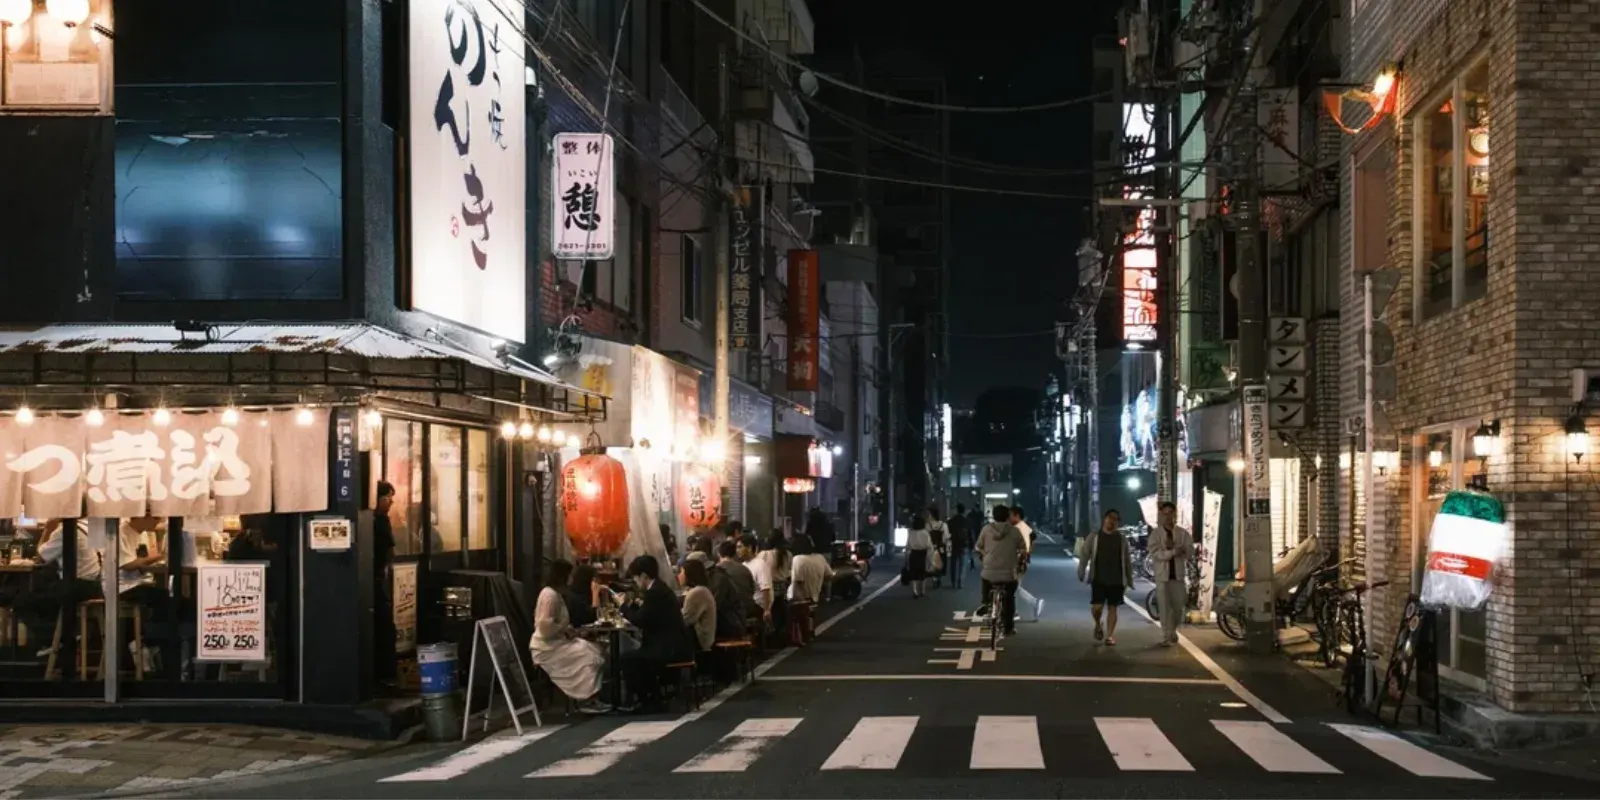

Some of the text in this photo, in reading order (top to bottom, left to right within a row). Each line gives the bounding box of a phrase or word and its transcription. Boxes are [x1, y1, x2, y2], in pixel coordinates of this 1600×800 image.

[433, 0, 493, 271] のんき
[561, 141, 602, 155] 整体
[567, 168, 598, 178] いこい
[561, 181, 602, 231] 憩
[1275, 319, 1302, 425] タンメン
[5, 426, 251, 503] つ煮込
